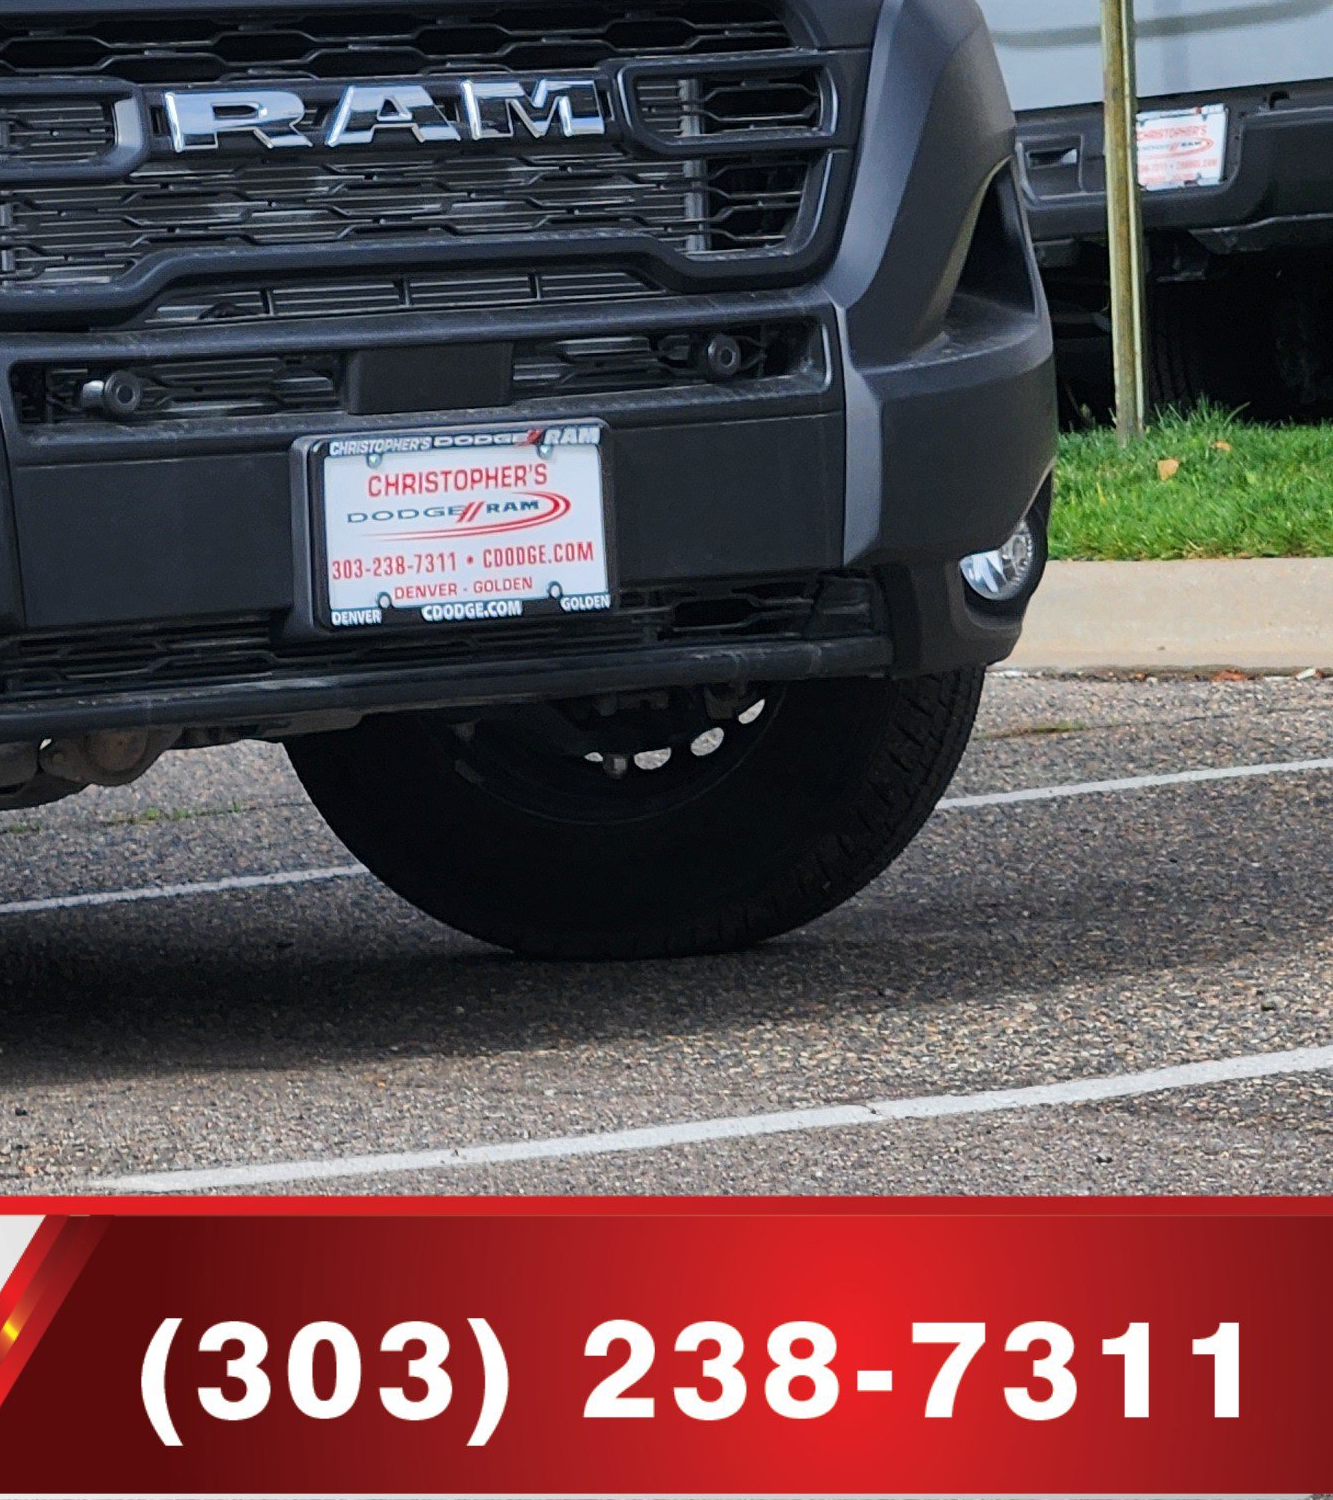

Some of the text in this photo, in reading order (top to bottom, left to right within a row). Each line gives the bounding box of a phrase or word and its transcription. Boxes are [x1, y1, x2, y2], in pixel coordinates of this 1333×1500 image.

[163, 77, 605, 153] RAM
[329, 427, 601, 456] CHRISTOPHER'S DODGE RAM
[368, 463, 548, 498] CHRISTOPHER'S
[346, 499, 540, 524] DODGE RAM
[332, 541, 594, 580] 303-238-7311 CDODGE.COM
[394, 583, 458, 600] DENVER
[473, 576, 533, 593] GOLDEN
[332, 593, 611, 626] DENVER CDODGE.COM GOLDEN
